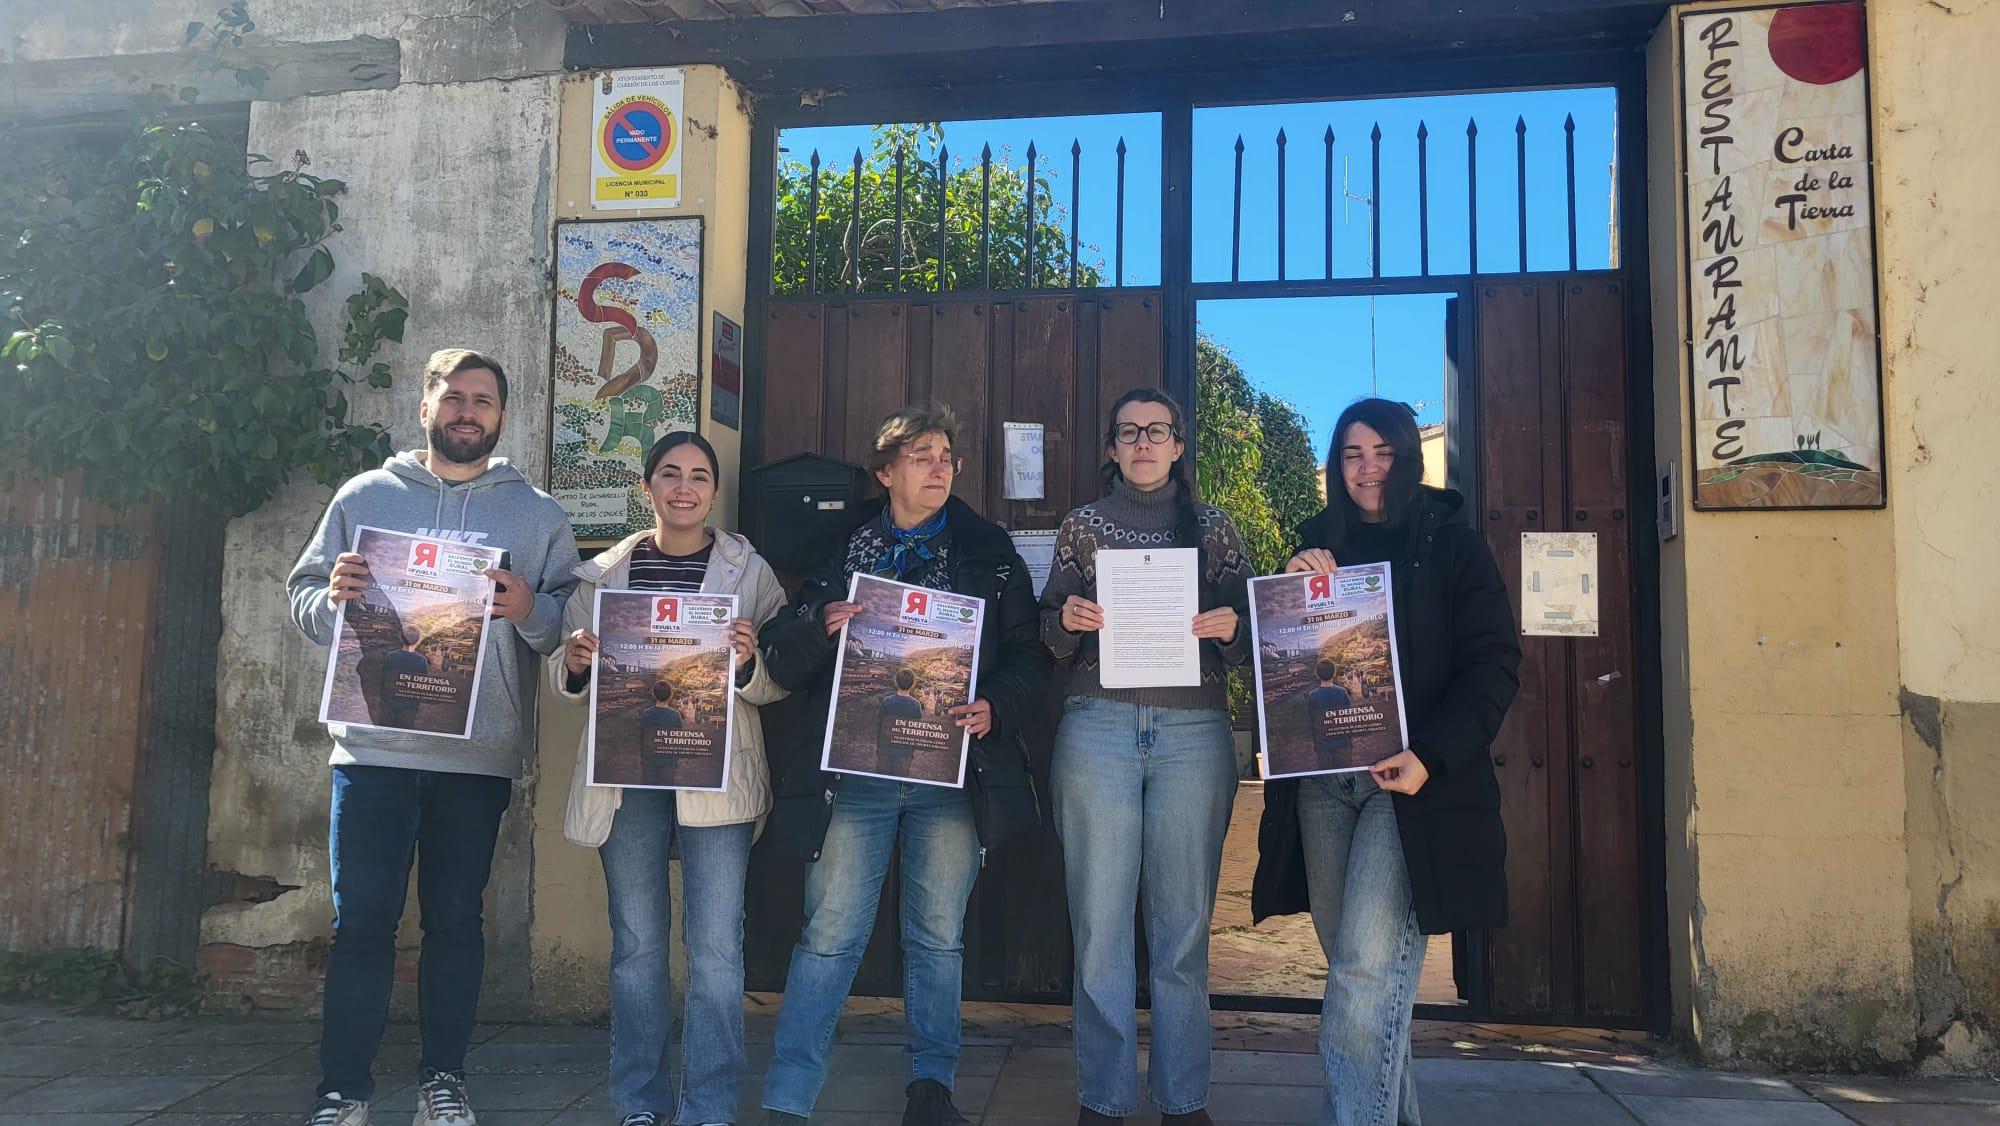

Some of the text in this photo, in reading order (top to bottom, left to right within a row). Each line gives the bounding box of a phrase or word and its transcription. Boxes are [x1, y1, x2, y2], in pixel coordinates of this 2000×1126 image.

[604, 100, 625, 119] SALIDA
[637, 96, 672, 117] VEHÍCULOS
[616, 136, 658, 144] PERMANENTE
[1774, 127, 1853, 163] Carta
[1794, 171, 1853, 192] de la
[1775, 194, 1854, 230] Tierra
[1700, 16, 1746, 461] RESTAURANTE
[423, 584, 448, 592] MARZO
[1324, 612, 1348, 620] MARZO
[868, 628, 885, 636] 12:00
[915, 630, 939, 638] MARZO
[414, 676, 449, 685] DEFENSA
[406, 682, 456, 693] TERRITORIO
[1339, 706, 1375, 716] DEFENSA
[1334, 713, 1384, 724] TERRITORIO
[909, 721, 942, 731] DEFENSA
[670, 730, 704, 738] DEFENSA
[902, 728, 949, 739] TERRITORIO
[664, 738, 711, 746] TERRITORIO
